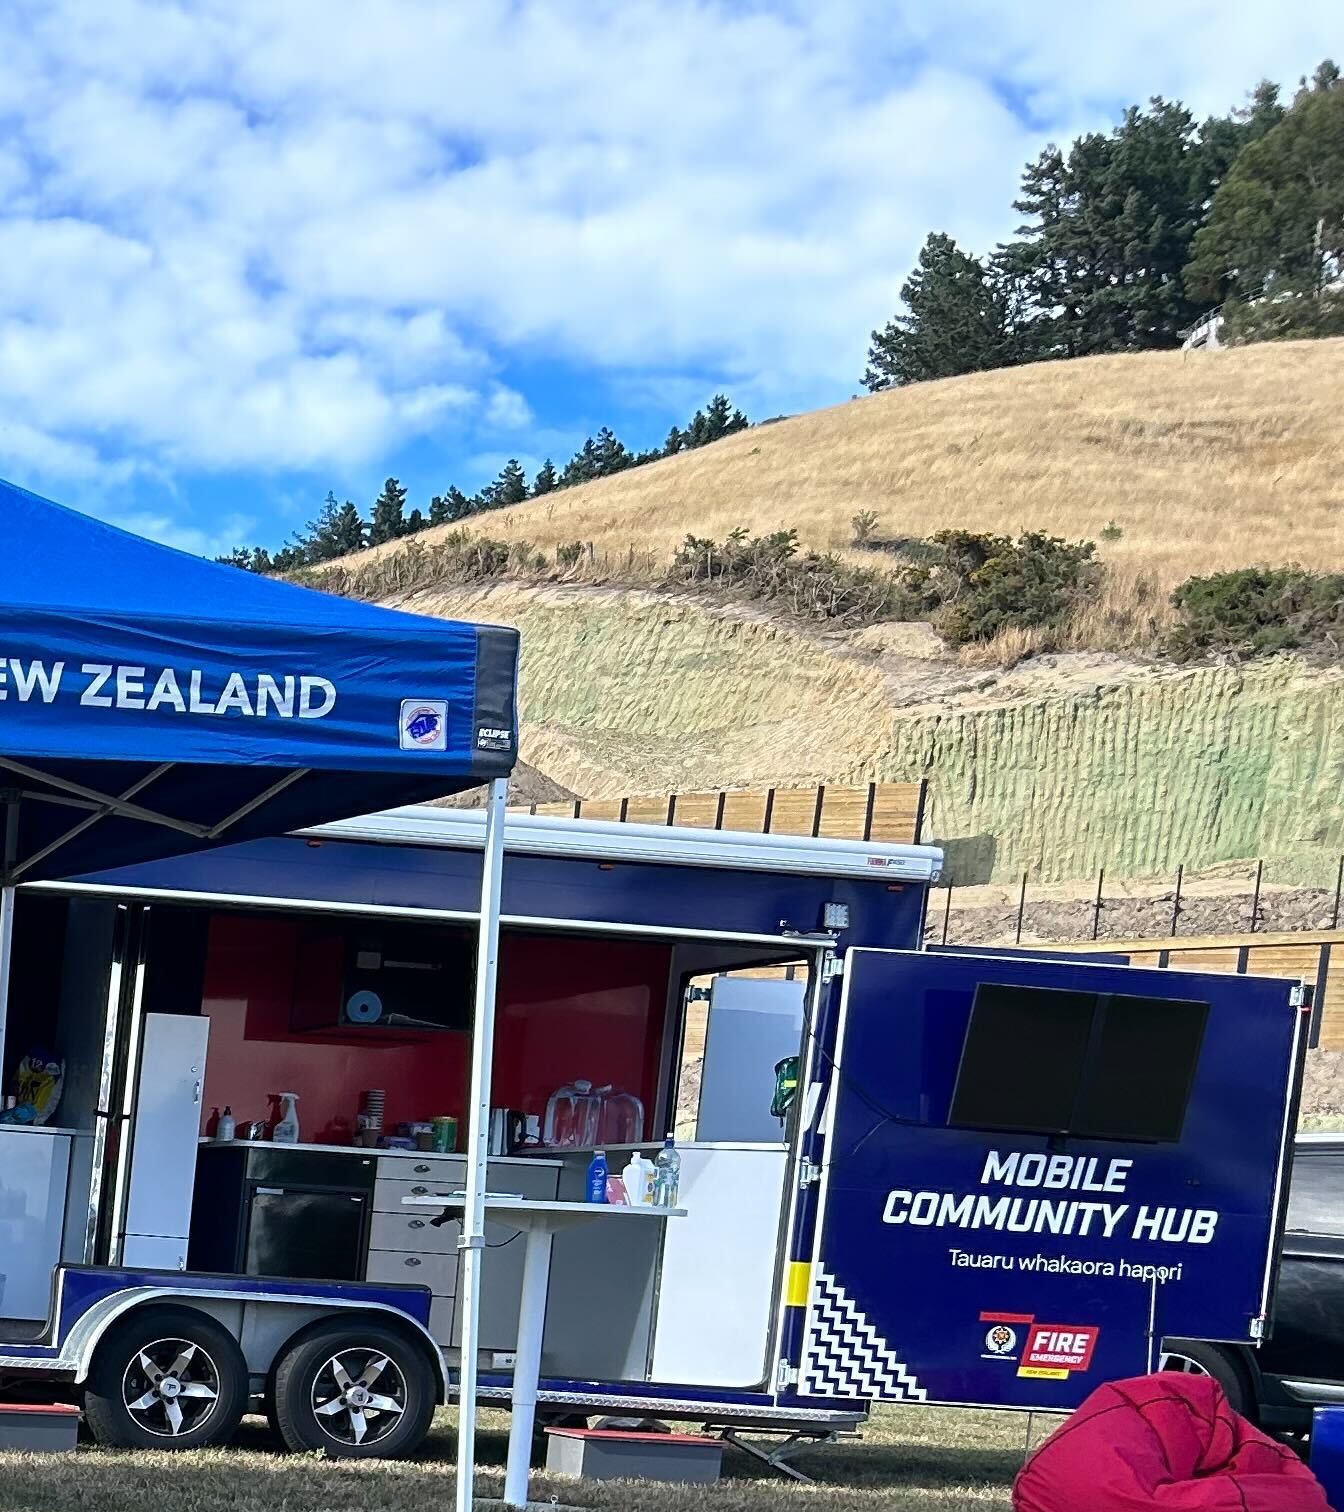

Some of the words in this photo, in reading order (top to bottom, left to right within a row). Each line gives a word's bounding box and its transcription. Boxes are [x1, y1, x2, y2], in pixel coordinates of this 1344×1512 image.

[79, 663, 337, 719] ZEALAND
[980, 1150, 1133, 1193] MOBILE
[882, 1190, 1129, 1238] COMMUNITY
[1131, 1206, 1219, 1244] HUB
[949, 1249, 1014, 1270] Tauaru
[1018, 1252, 1115, 1276] whakaora
[1119, 1259, 1183, 1281] hapori
[1029, 1353, 1084, 1364] EMERGENCY
[1033, 1331, 1089, 1353] FIRE
